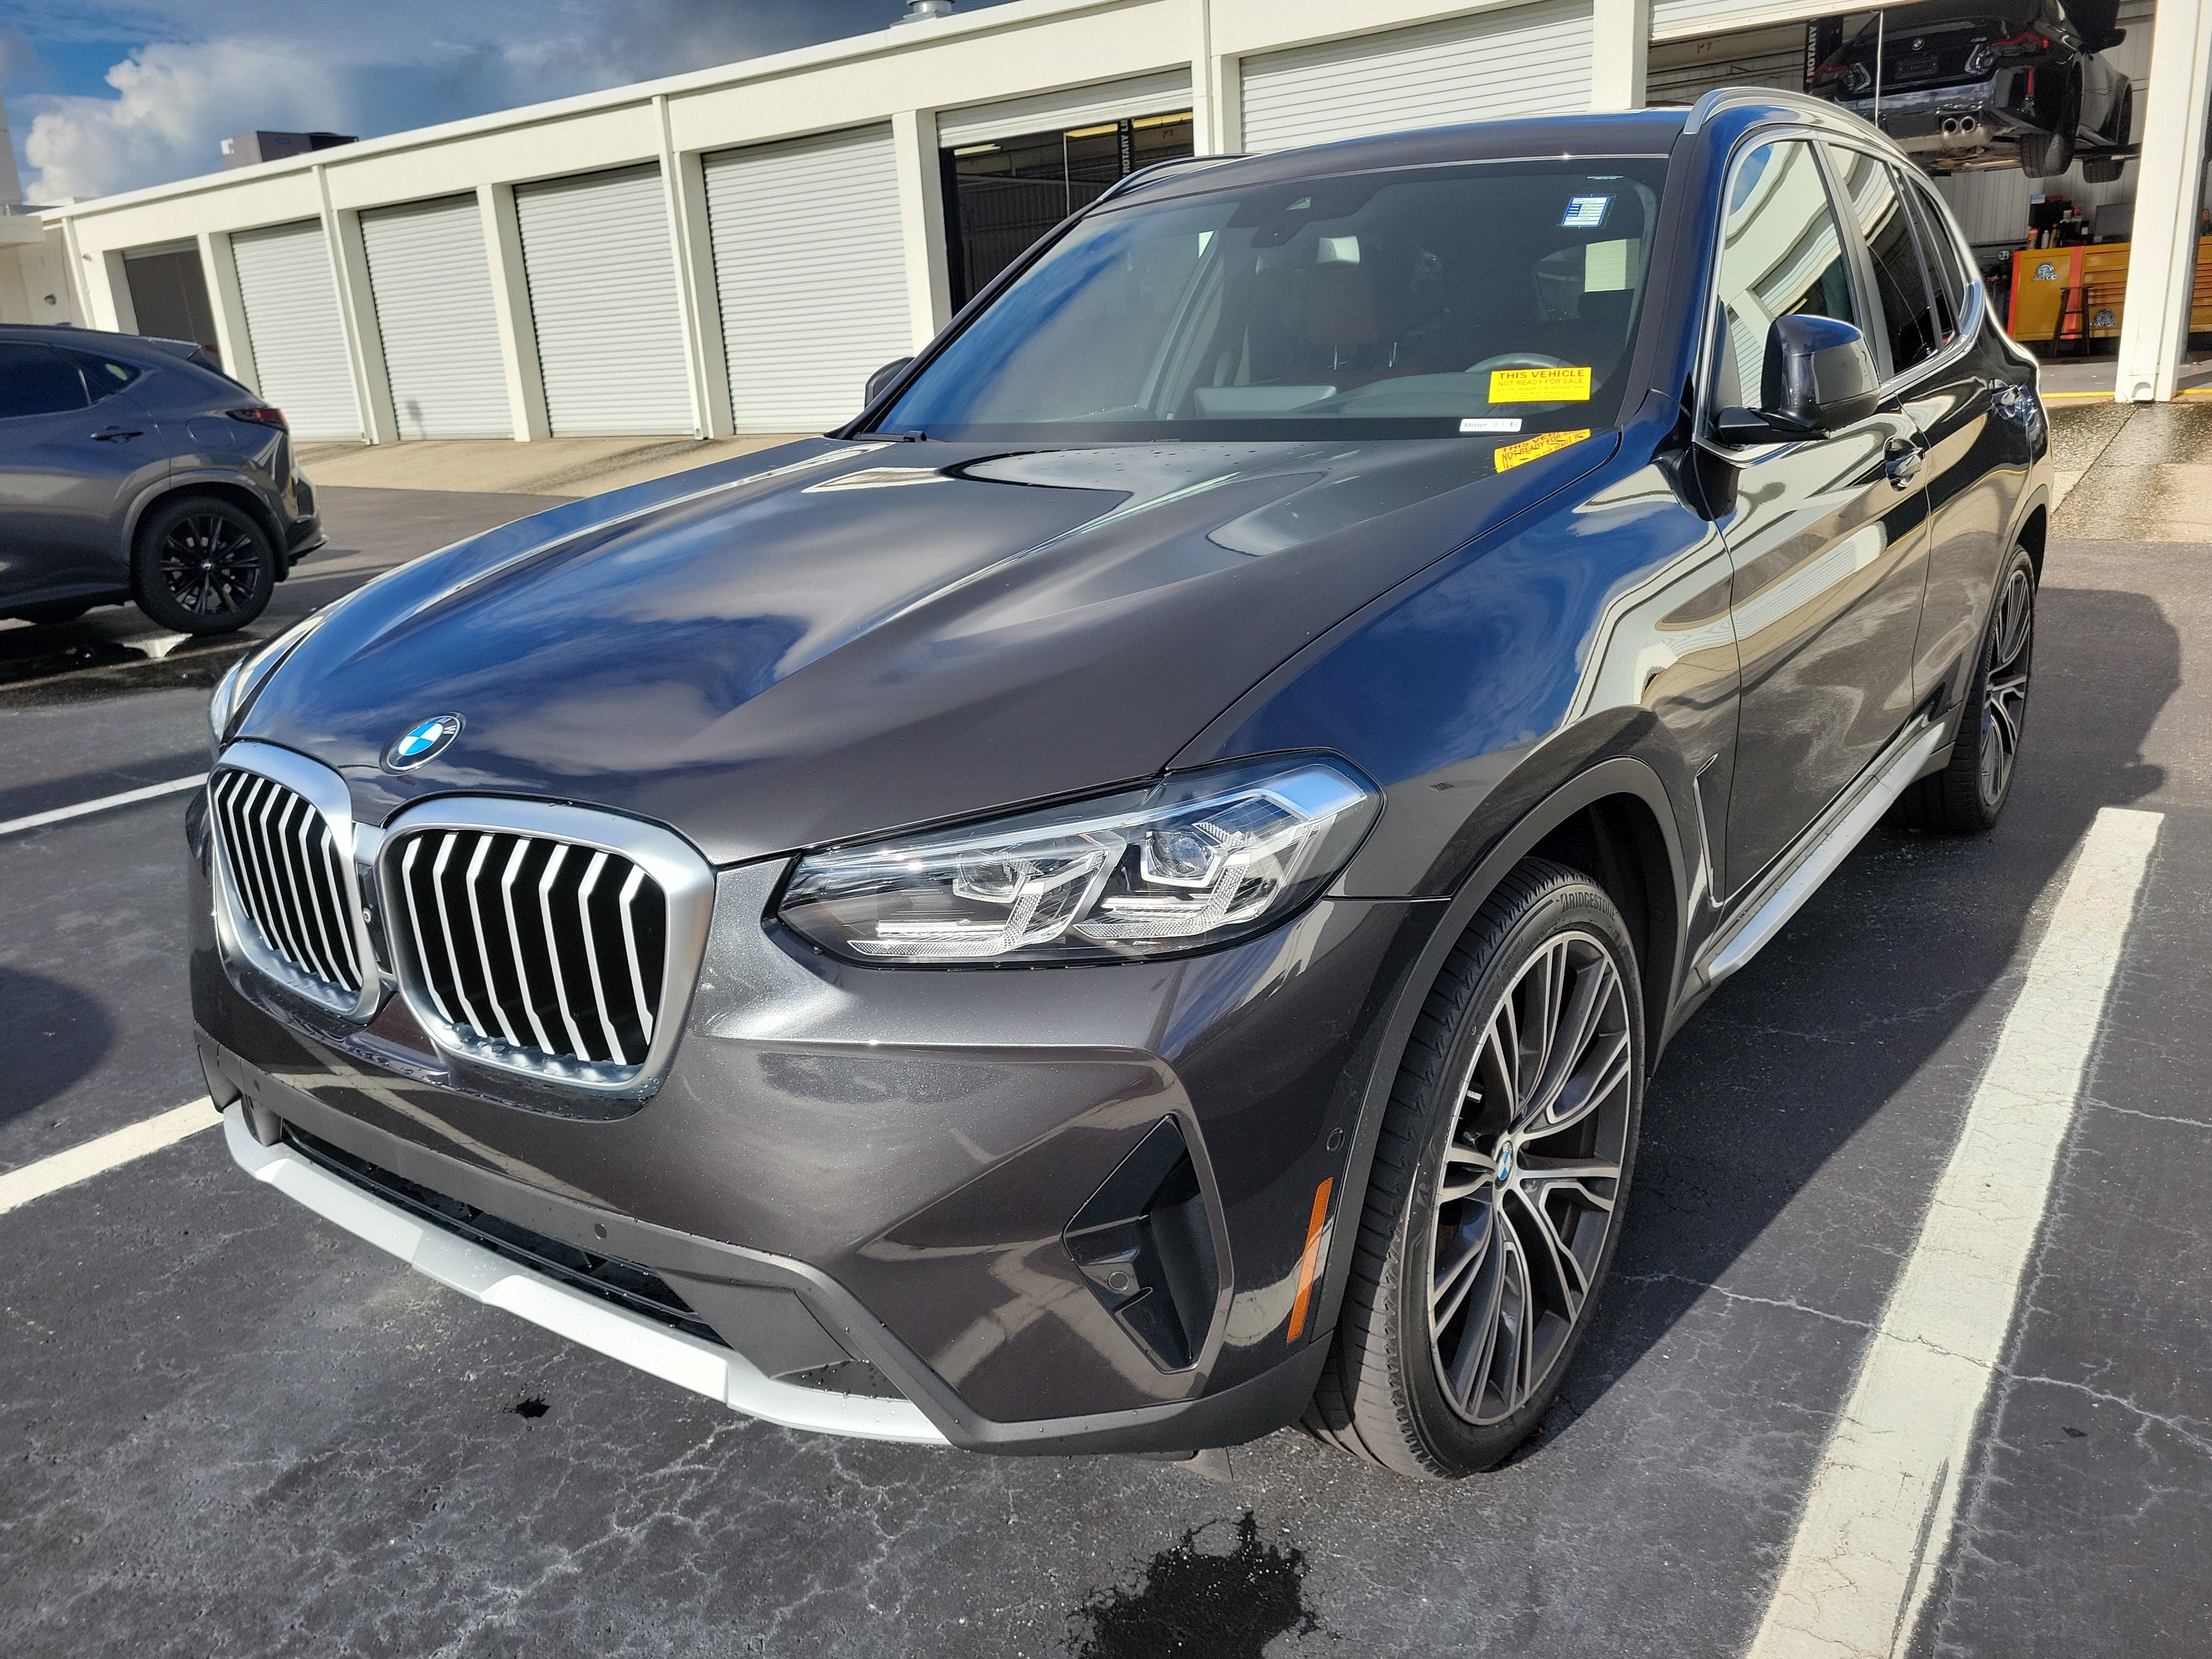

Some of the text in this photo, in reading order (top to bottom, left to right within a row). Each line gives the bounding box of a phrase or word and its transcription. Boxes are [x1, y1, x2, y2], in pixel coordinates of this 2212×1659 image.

[1807, 25, 1817, 77] ROTARY
[1121, 134, 1130, 174] ROTARY
[1531, 370, 1584, 378] VEHICLE
[1502, 452, 1520, 460] NOT
[1519, 441, 1544, 455] READY
[1547, 433, 1561, 445] FOR
[1502, 442, 1529, 452] THIS
[1560, 891, 1615, 922] BRIDGESTONE
